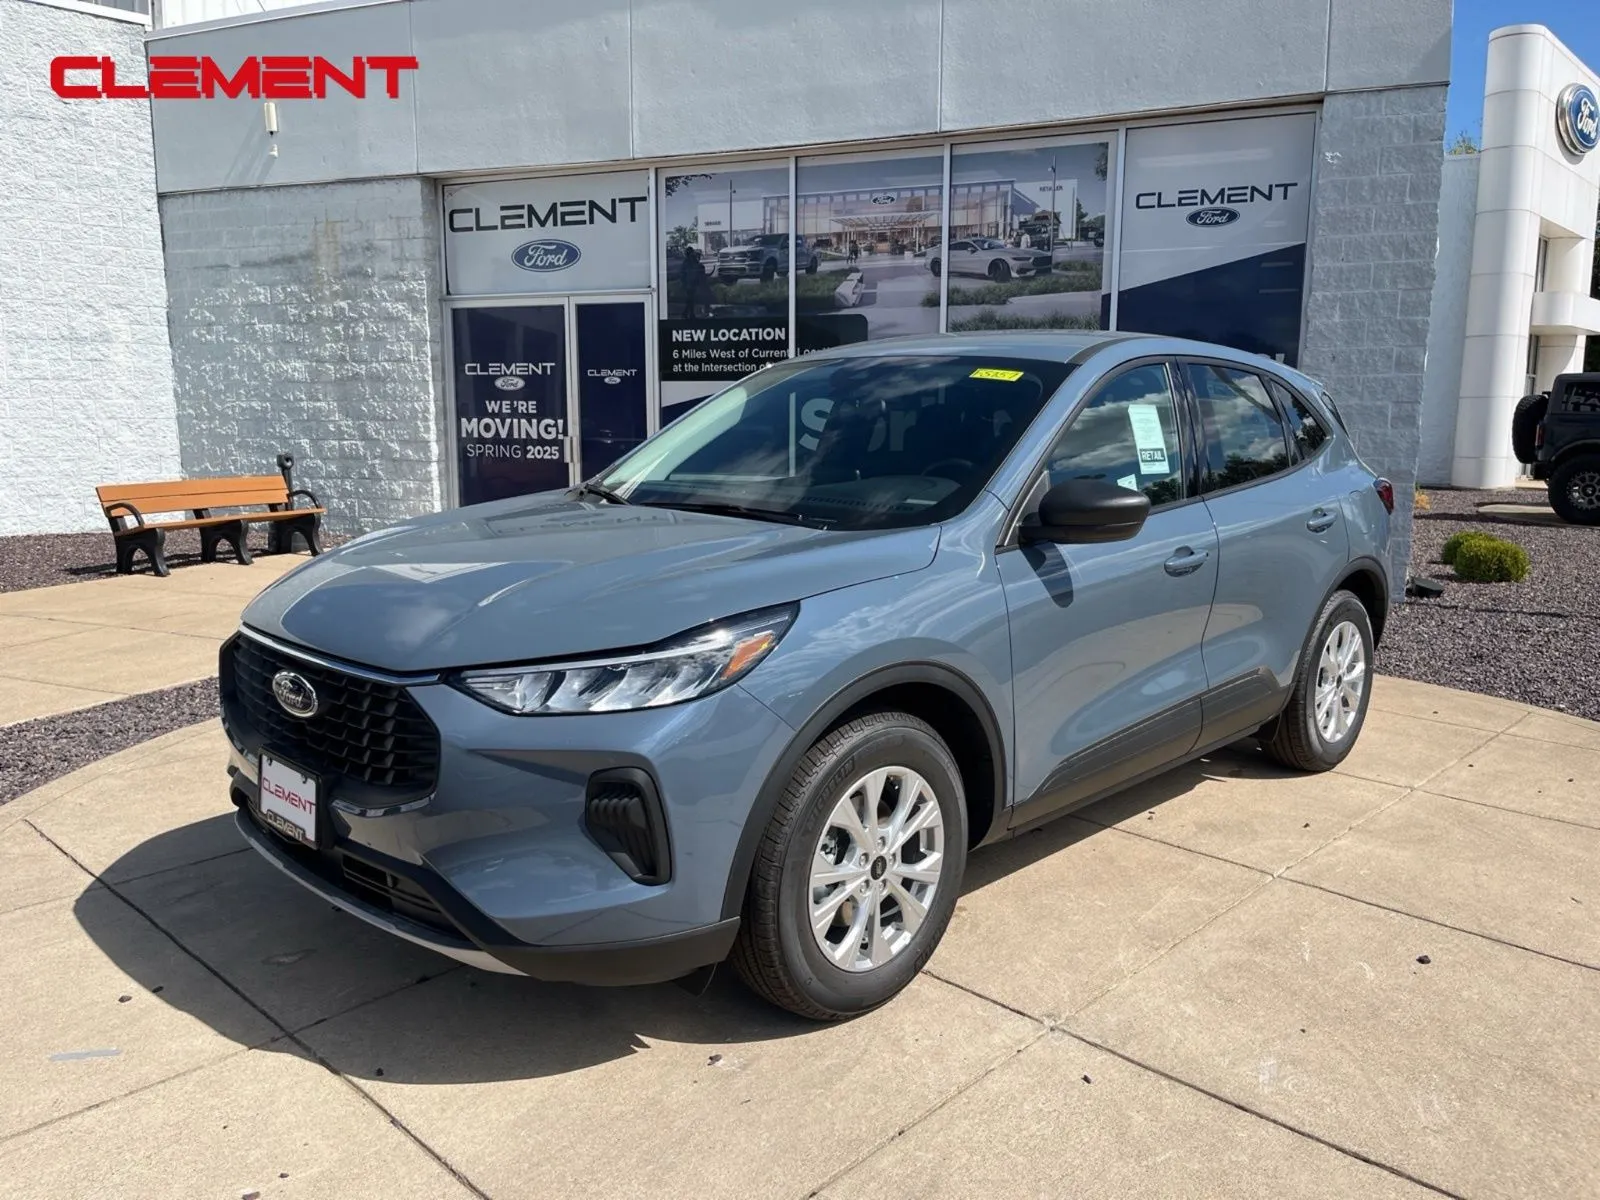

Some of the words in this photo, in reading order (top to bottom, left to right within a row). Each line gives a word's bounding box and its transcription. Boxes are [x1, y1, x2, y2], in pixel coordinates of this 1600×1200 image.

[1576, 96, 1599, 140] Ford
[1135, 182, 1299, 210] CLEMENT
[448, 195, 648, 233] CLEMENT
[1195, 209, 1230, 225] Ford
[522, 242, 570, 268] Ford
[672, 329, 706, 342] NEW
[710, 327, 786, 342] LOCATION
[672, 349, 679, 359] 6
[681, 348, 707, 359] Miles
[710, 349, 736, 359] West
[738, 348, 749, 358] of
[464, 362, 556, 376] CLEMENT
[587, 368, 638, 377] CLEMENT
[672, 363, 682, 373] at
[683, 362, 700, 373] the
[701, 361, 757, 372] Intersection
[485, 400, 537, 414] WE'RE
[460, 417, 564, 440] MOVING!
[466, 444, 522, 459] SPRING
[526, 445, 560, 460] 2025
[1141, 450, 1165, 461] RETAIL
[262, 776, 316, 815] CLEMENT
[266, 810, 305, 842] CLEMENT
